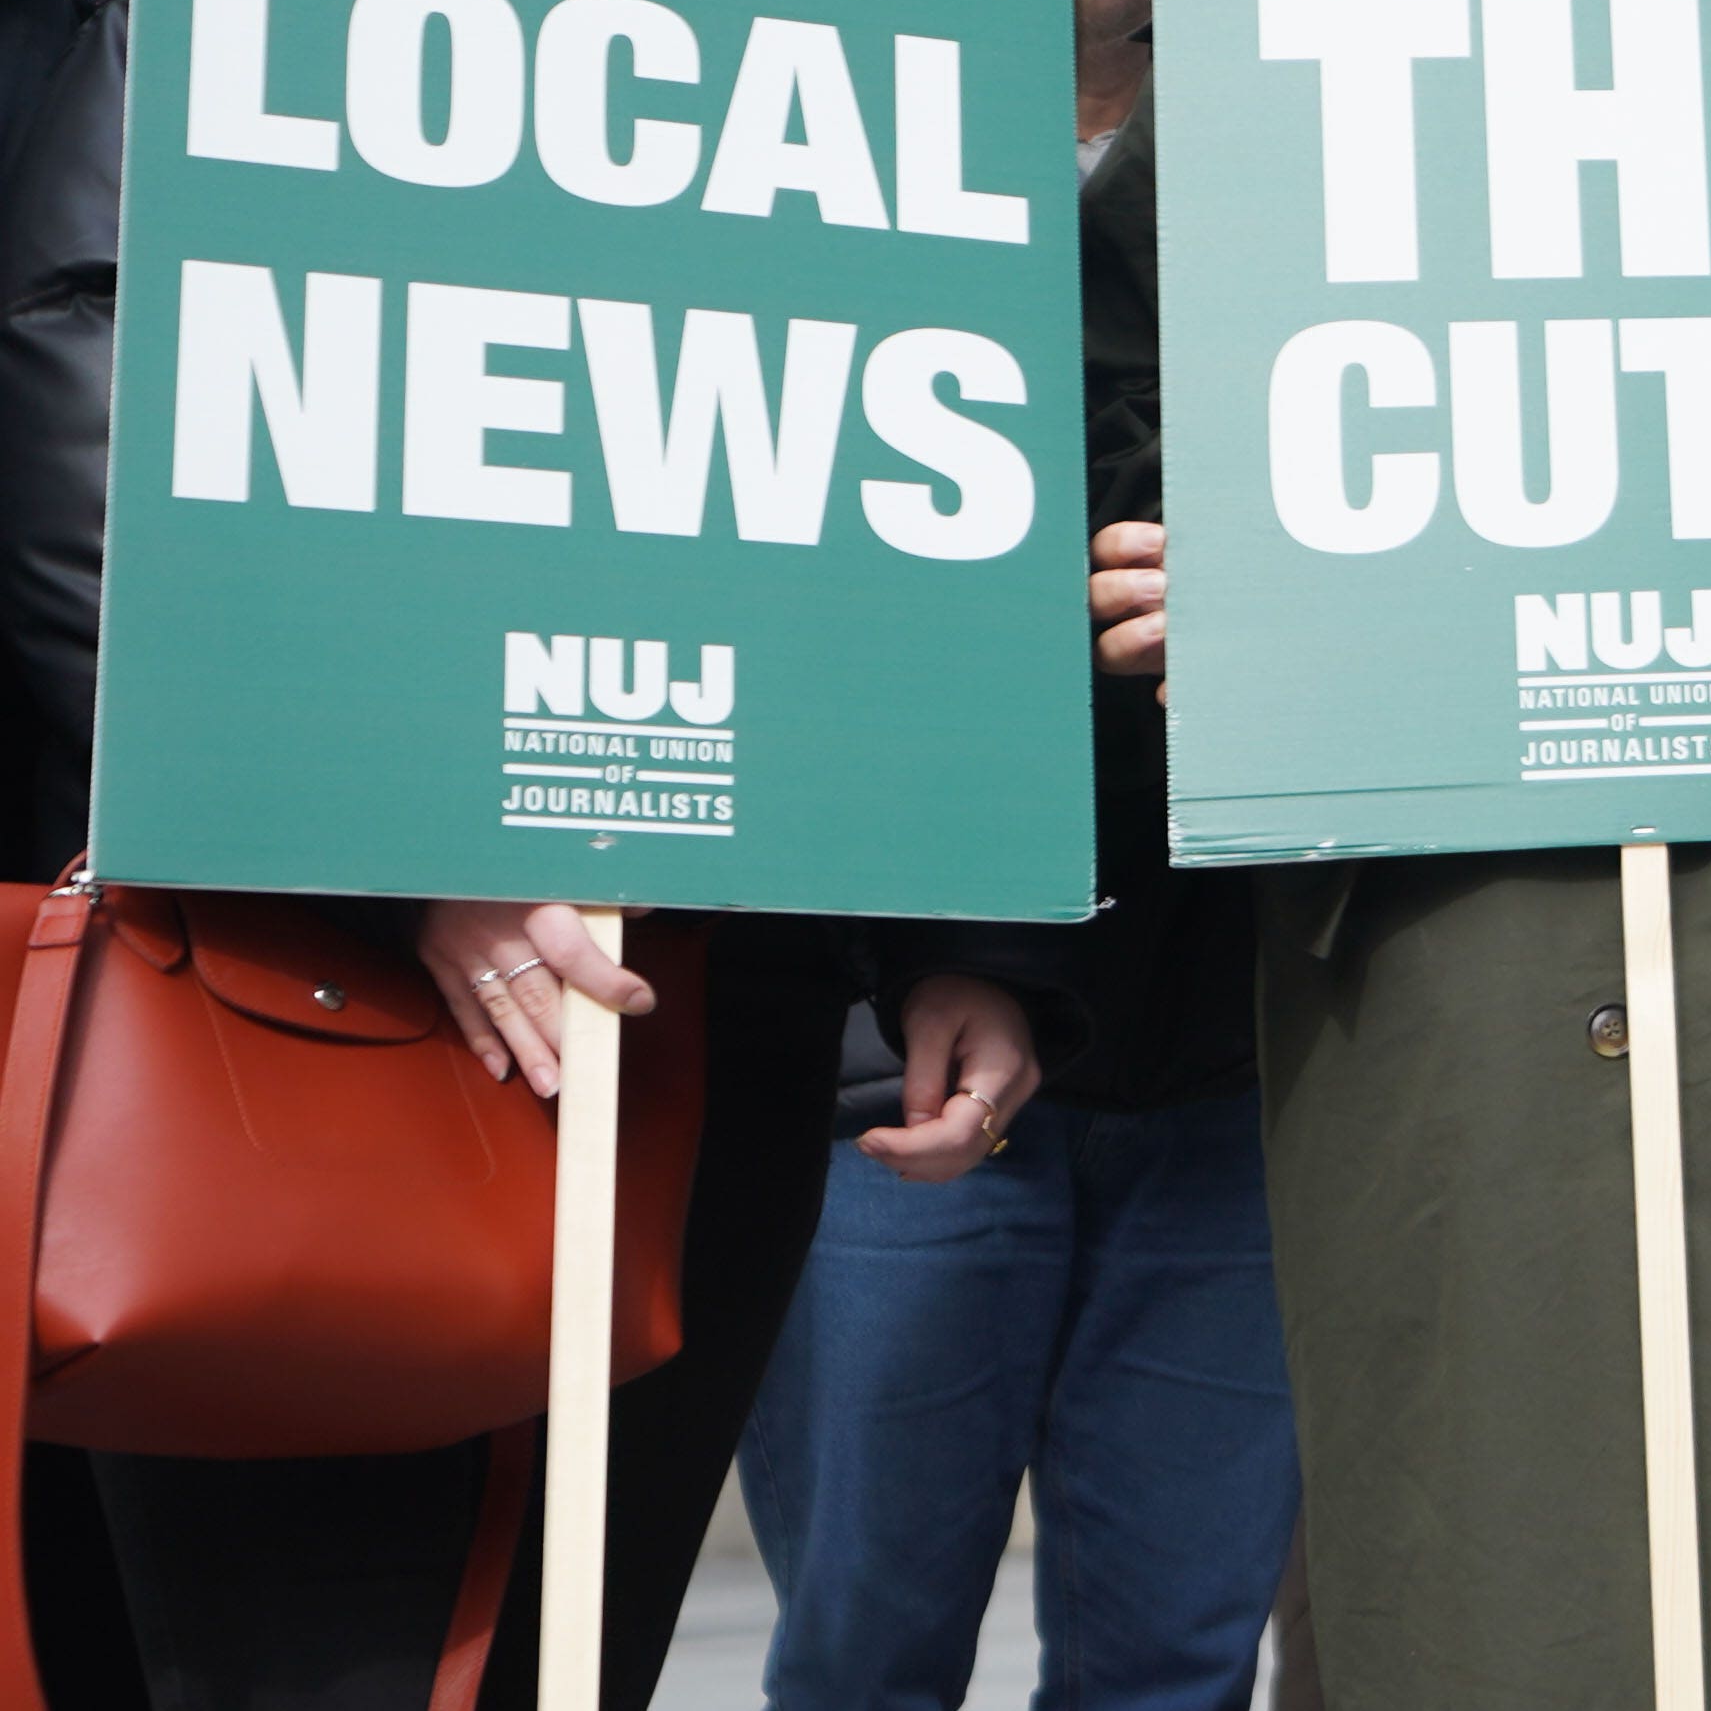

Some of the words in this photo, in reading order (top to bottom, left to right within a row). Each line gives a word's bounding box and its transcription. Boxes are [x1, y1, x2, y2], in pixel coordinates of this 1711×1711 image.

[171, 259, 1035, 561] NEWS
[504, 632, 734, 725] NUJ
[1519, 687, 1640, 709] NATIONAL
[1611, 714, 1637, 731] OF
[504, 730, 640, 758] NATIONAL
[650, 739, 733, 762] UNION
[605, 765, 635, 783] OF
[502, 785, 734, 820] JOURNALISTS
